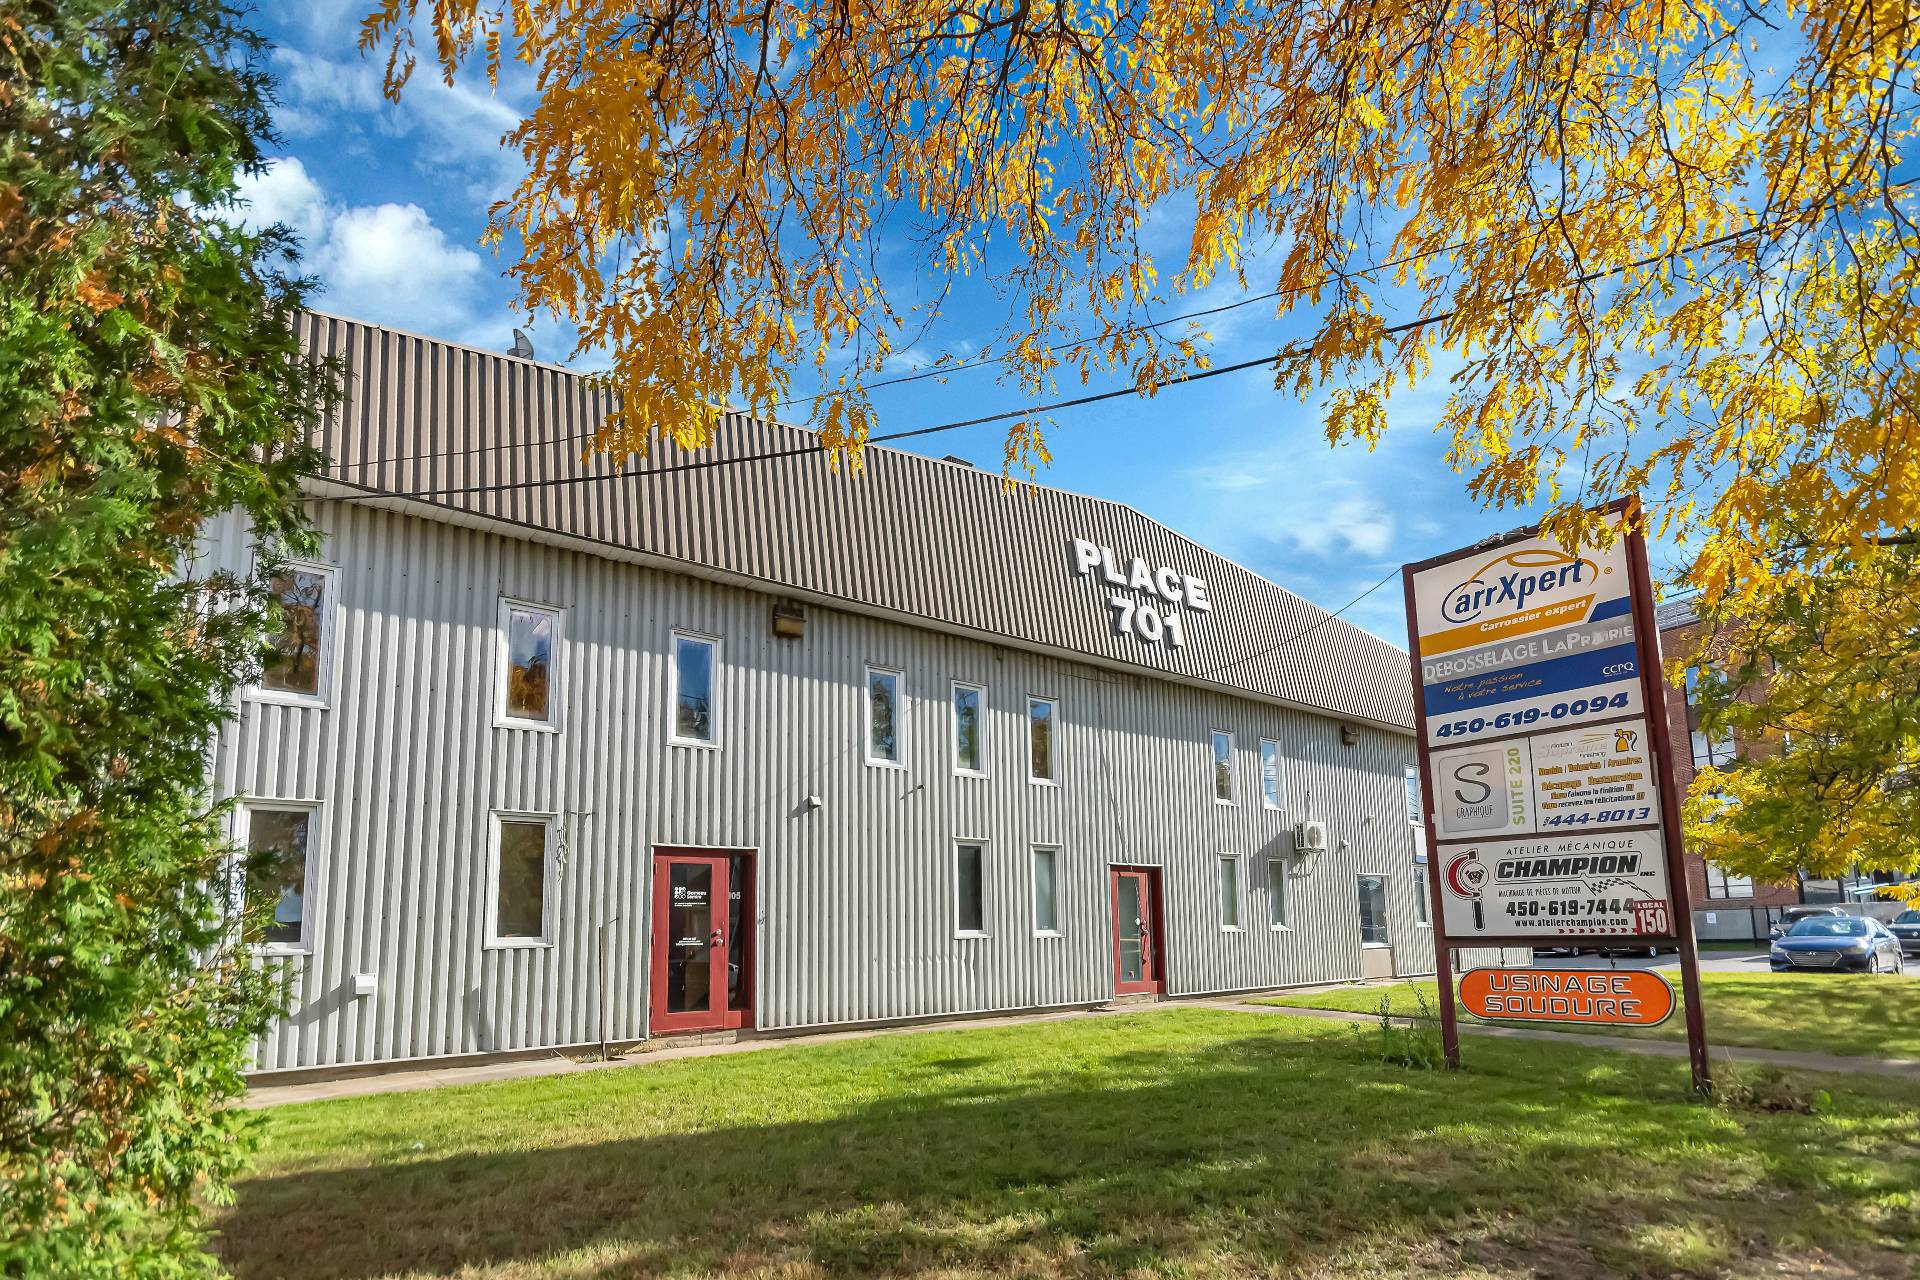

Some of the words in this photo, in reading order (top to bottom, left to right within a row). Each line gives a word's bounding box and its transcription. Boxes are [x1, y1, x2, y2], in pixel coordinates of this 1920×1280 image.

[1073, 537, 1212, 613] PLACE
[1110, 594, 1184, 648] 701
[1479, 610, 1541, 633] Carrossier
[1544, 598, 1588, 618] expert
[1424, 641, 1539, 681] DEBOSSELAGE
[1602, 661, 1635, 675] CCPQ
[1444, 682, 1475, 693] Notre
[1477, 672, 1524, 690] passion
[1468, 687, 1497, 699] votre
[1502, 679, 1543, 692] service
[1436, 691, 1630, 738] 450-619-0094
[1506, 747, 1522, 775] 220
[1568, 787, 1592, 798] faisons
[1599, 785, 1625, 795] finition
[1456, 804, 1494, 819] GRAPHIQUE
[1509, 780, 1526, 825] SUITE
[1558, 799, 1583, 808] recevez
[1548, 807, 1651, 827] 444-8013
[1506, 844, 1549, 856] ATELIER
[1557, 839, 1635, 853] MÉCANIQUE
[1497, 854, 1639, 879] CHAMPION
[1526, 888, 1534, 897] DE
[1552, 887, 1560, 896] DE
[1561, 886, 1582, 895] MOTEUR
[1505, 898, 1635, 917] 450-619-7444
[1514, 917, 1629, 929] www.atelierchampion.com
[1638, 908, 1667, 933] 150
[1489, 973, 1632, 995] USINAGE
[1484, 995, 1643, 1018] SOUDURE
